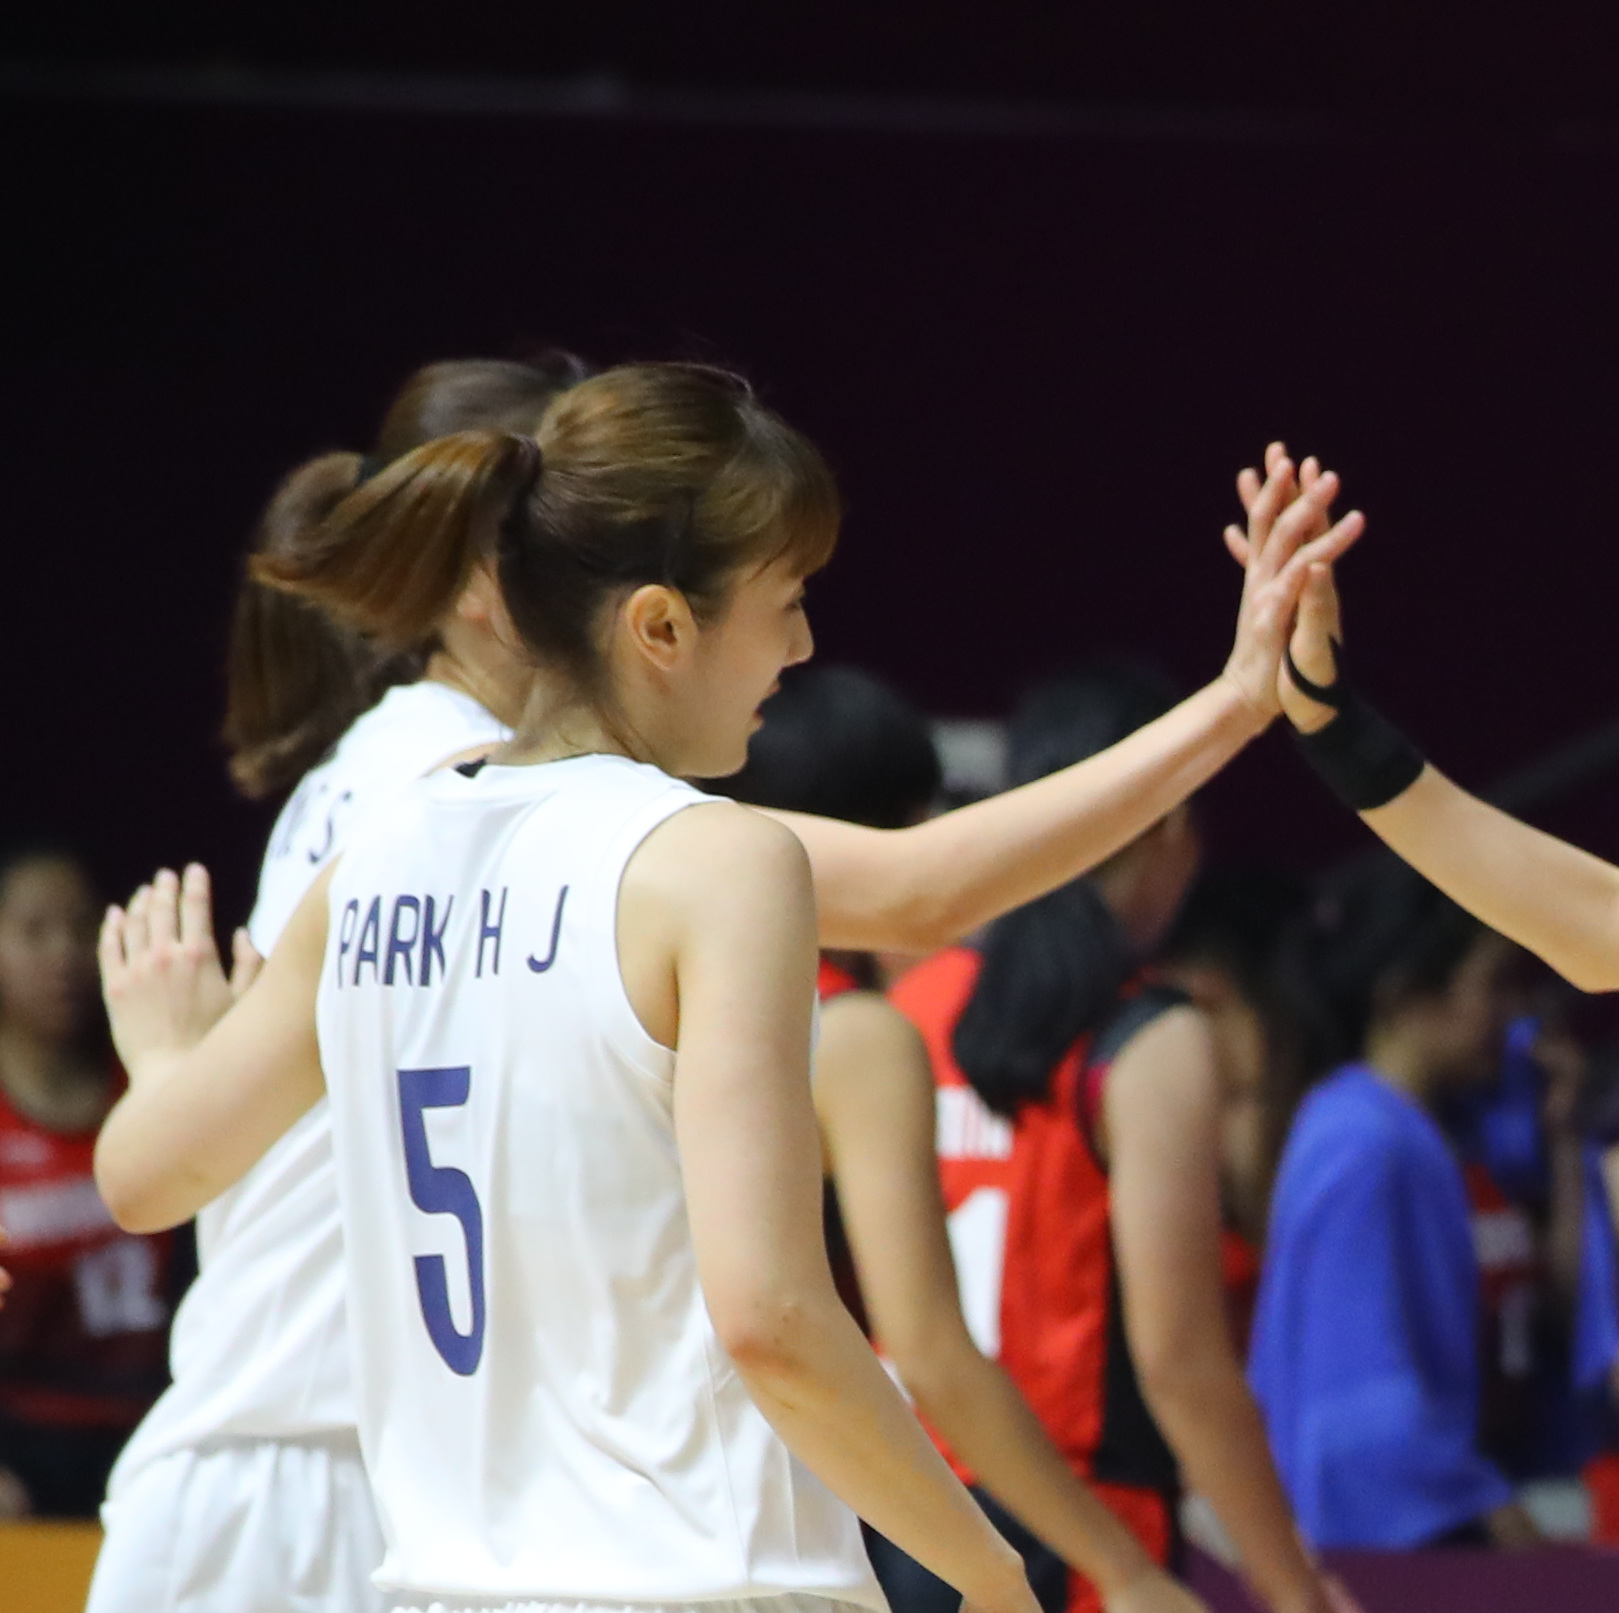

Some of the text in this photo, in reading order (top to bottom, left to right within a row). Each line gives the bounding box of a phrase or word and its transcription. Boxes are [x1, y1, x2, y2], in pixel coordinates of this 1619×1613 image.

[338, 884, 570, 988] PARK H J
[396, 1065, 487, 1378] 5
